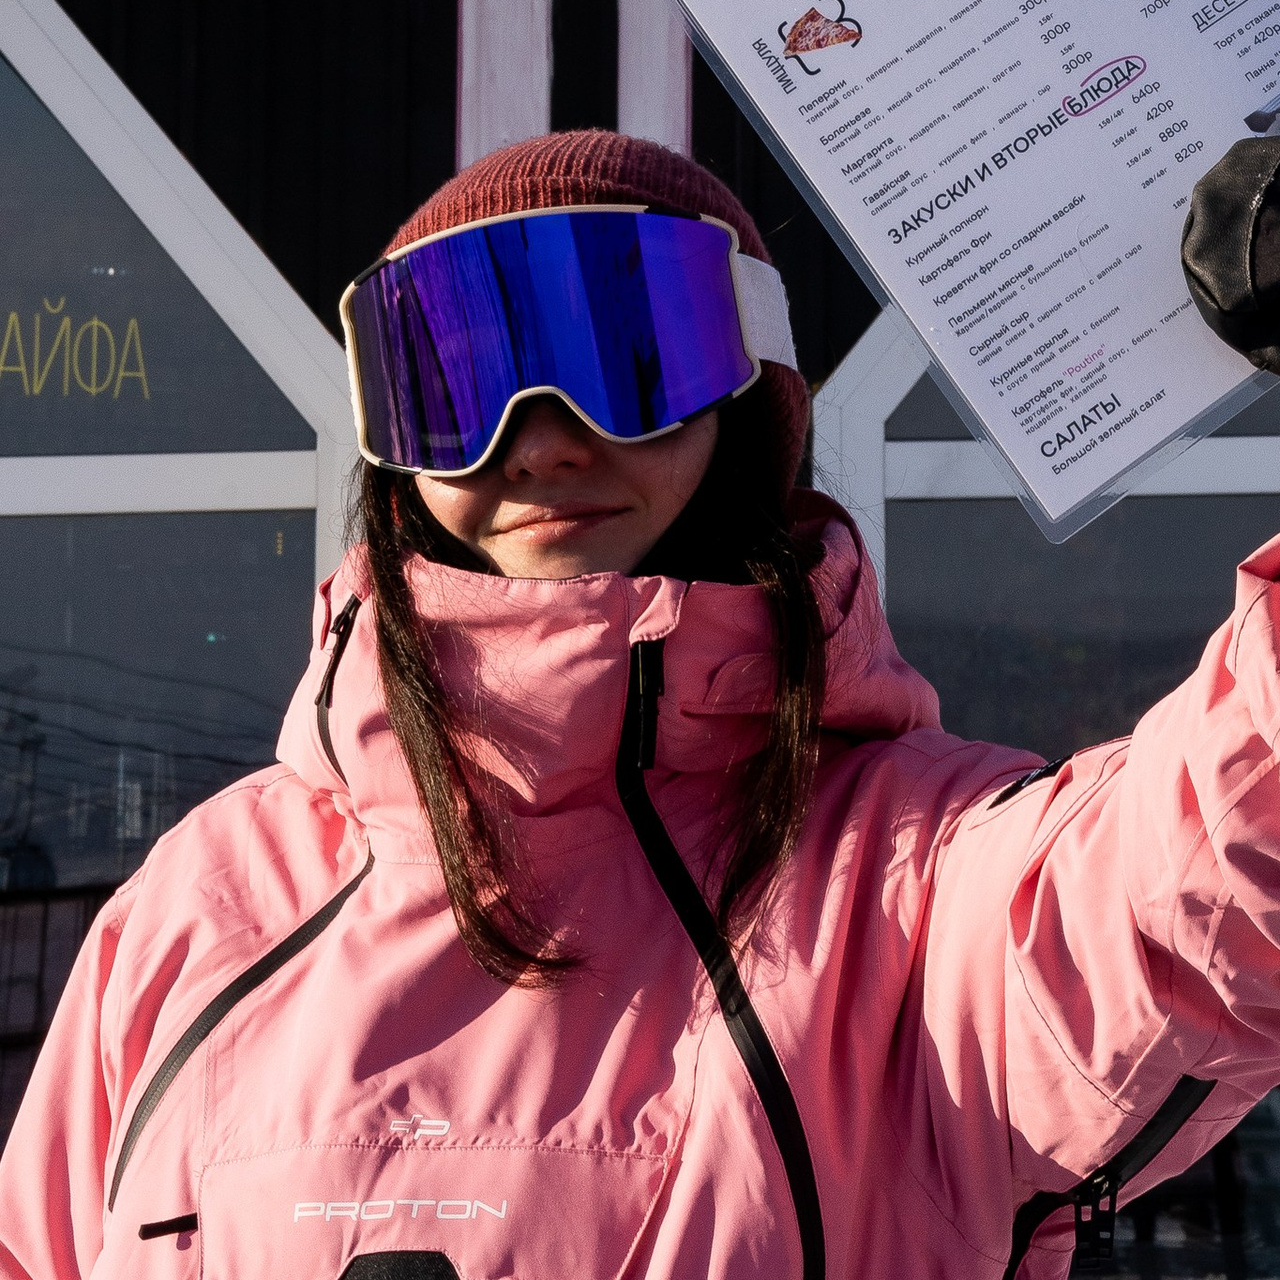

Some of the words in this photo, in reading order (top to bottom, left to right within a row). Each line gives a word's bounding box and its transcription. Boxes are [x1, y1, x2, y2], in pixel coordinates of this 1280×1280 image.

[1037, 12, 1054, 26] 150г
[1039, 20, 1071, 45] 300р
[1212, 31, 1237, 50] Торт
[1236, 27, 1245, 36] в
[1243, 2, 1280, 31] стакане
[1236, 44, 1251, 59] 150г
[1253, 23, 1280, 45] 420р
[751, 36, 798, 95] ПИЦЦУЛЯ
[1059, 41, 1075, 56] 150г
[1061, 50, 1093, 74] 300р
[1243, 58, 1276, 82] Панна
[797, 78, 847, 116] Пеперони
[1097, 107, 1124, 129] 150/40г
[1130, 80, 1161, 104] 640р
[1261, 79, 1277, 93] 150г
[818, 106, 872, 146] Болоньезе
[1111, 125, 1138, 148] 150/40г
[1145, 98, 1174, 121] 420р
[1125, 145, 1152, 168] 150/40г
[1157, 118, 1189, 143] 880р
[840, 136, 894, 177] Маргарита
[886, 173, 976, 245] ЗАКУСКИ
[972, 161, 993, 183] И
[989, 106, 1069, 170] ВТОРЫЕ
[1065, 56, 1142, 117] БЛЮДА
[1173, 139, 1204, 163] 820р
[861, 169, 911, 207] Гавайская
[904, 231, 949, 268] Куриный
[947, 204, 989, 237] попкорн
[917, 247, 971, 287] Картофель
[969, 230, 992, 248] Фри
[931, 271, 979, 307] Креветки
[978, 256, 999, 275] фри
[998, 247, 1012, 260] со
[1010, 217, 1053, 251] сладким
[1051, 193, 1086, 222] васаби
[947, 289, 998, 328] Пельмени
[996, 263, 1034, 293] мясные
[968, 322, 1010, 357] Сырный
[1009, 310, 1030, 328] сыр
[988, 353, 1033, 388] Куриные
[1032, 327, 1069, 357] крылья
[1010, 378, 1064, 418] Картофель
[1060, 341, 1110, 381] "Poutine"
[1039, 391, 1122, 458] САЛАТЫ
[1050, 437, 1098, 475] Большой
[1097, 407, 1140, 443] зеленый
[1138, 387, 1166, 412] салат
[293, 1199, 509, 1223] PROTON
